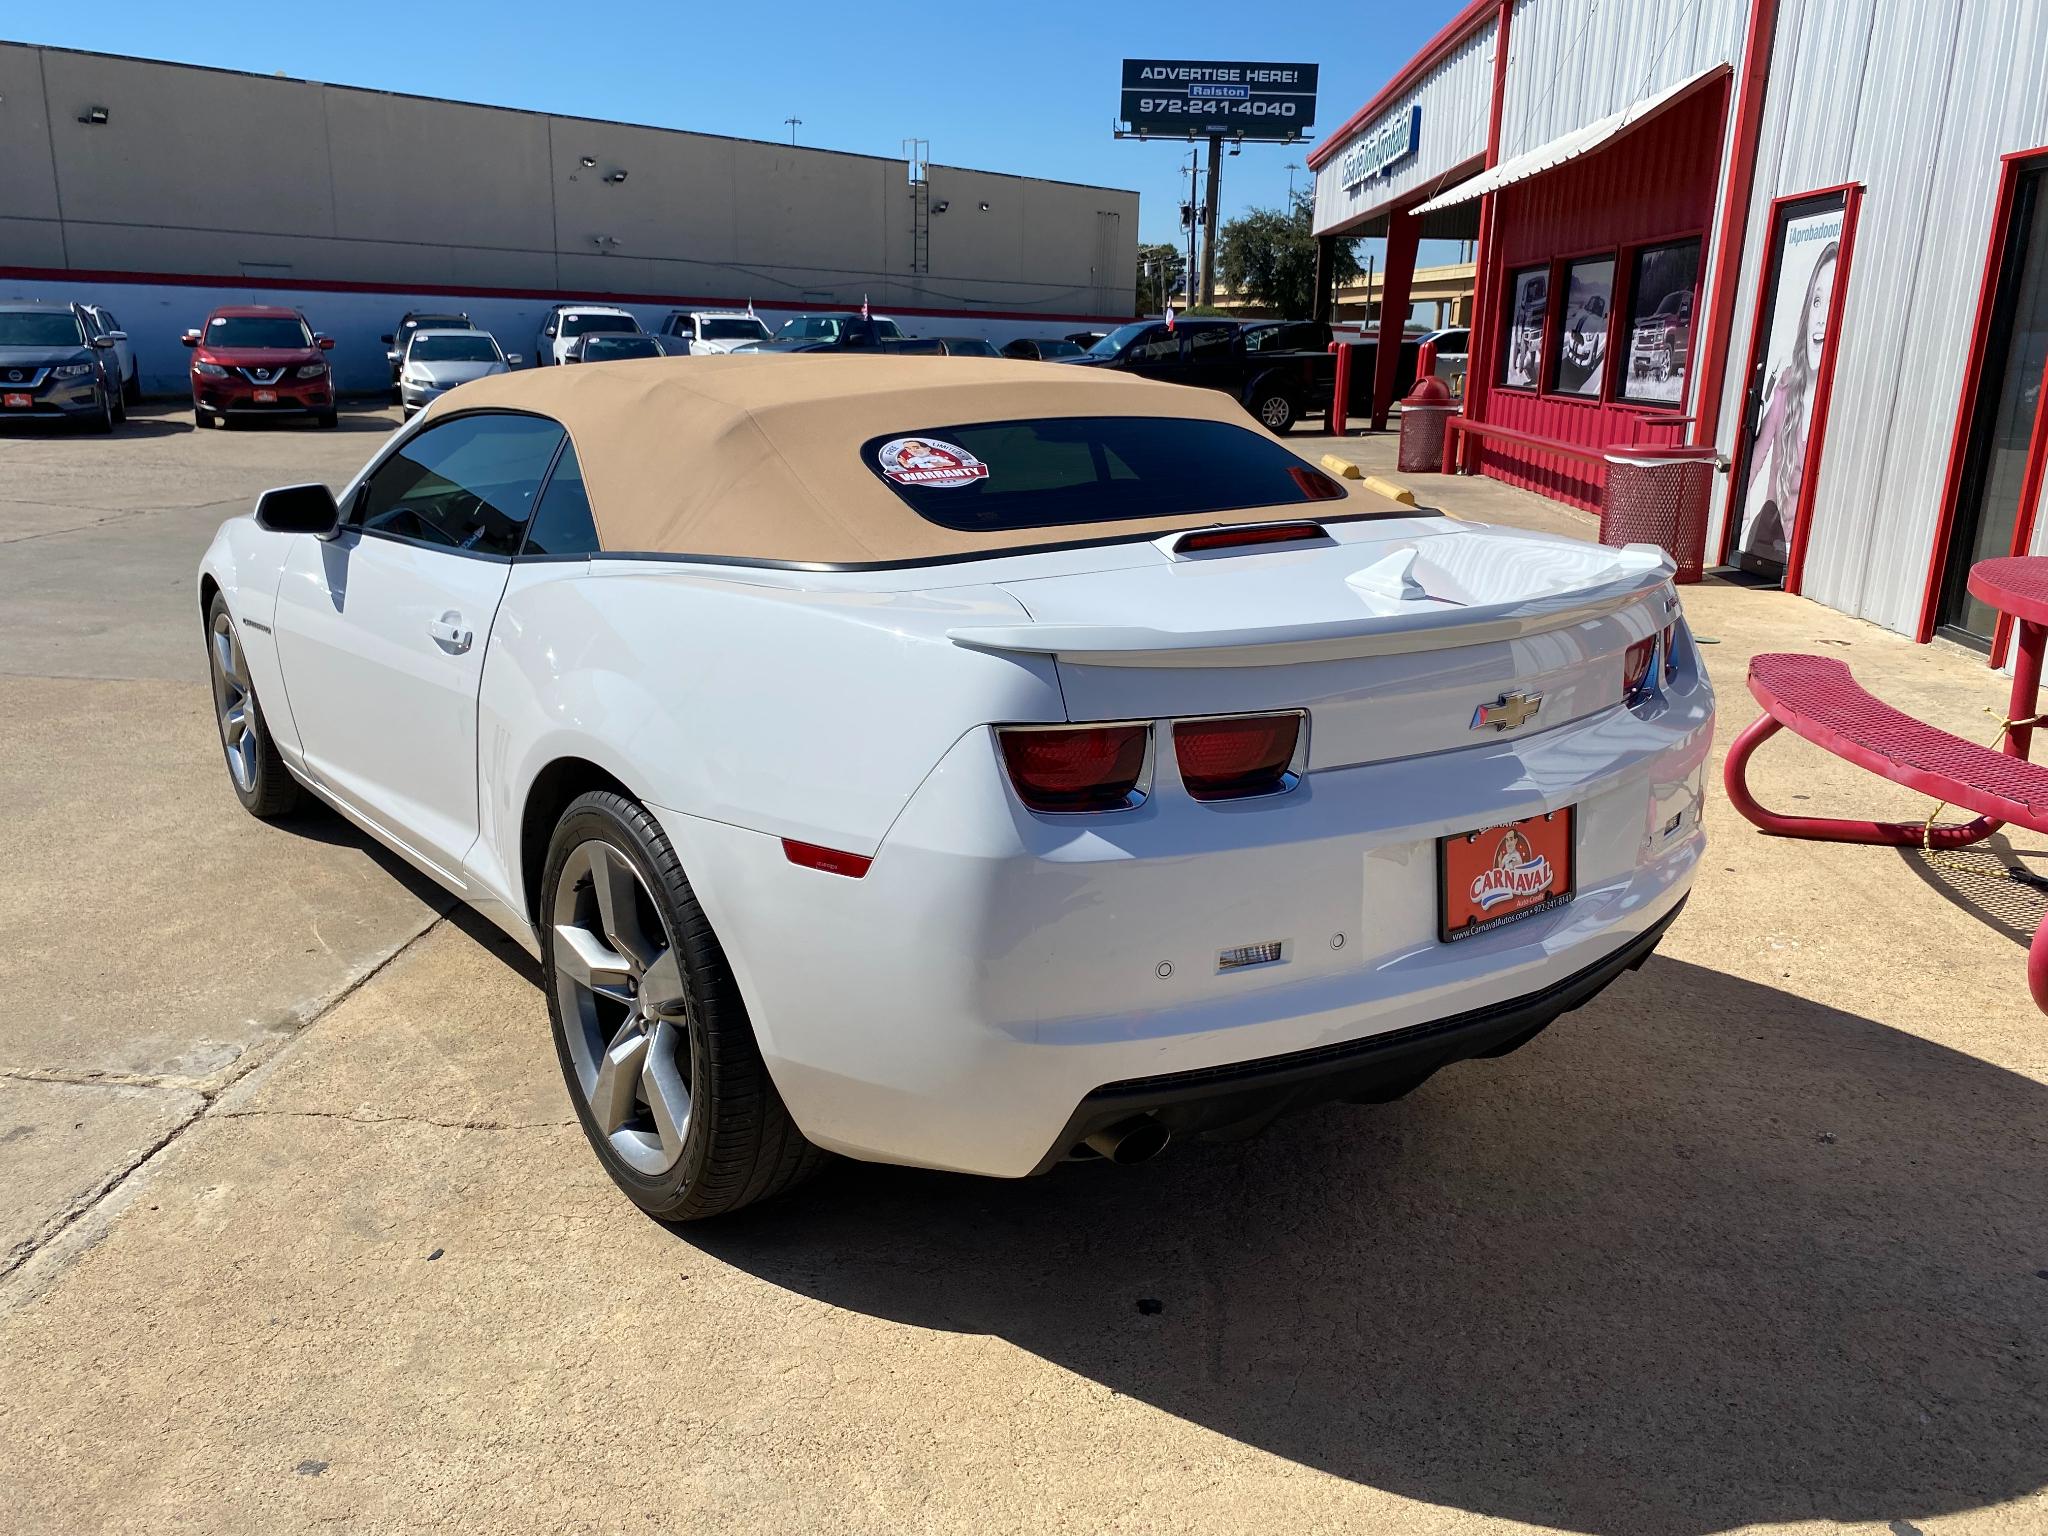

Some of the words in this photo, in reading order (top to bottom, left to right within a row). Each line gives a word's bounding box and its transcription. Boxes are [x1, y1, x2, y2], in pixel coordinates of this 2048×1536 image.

[1140, 67, 1240, 82] ADVERTISE
[1245, 69, 1299, 83] HERE!
[1192, 86, 1245, 97] Ralston
[1139, 98, 1296, 116] 972-241-4040
[898, 467, 980, 481] WARRANTY
[1471, 863, 1552, 900] CARNAVAL
[1452, 909, 1530, 941] www.CarnavalAutos.com
